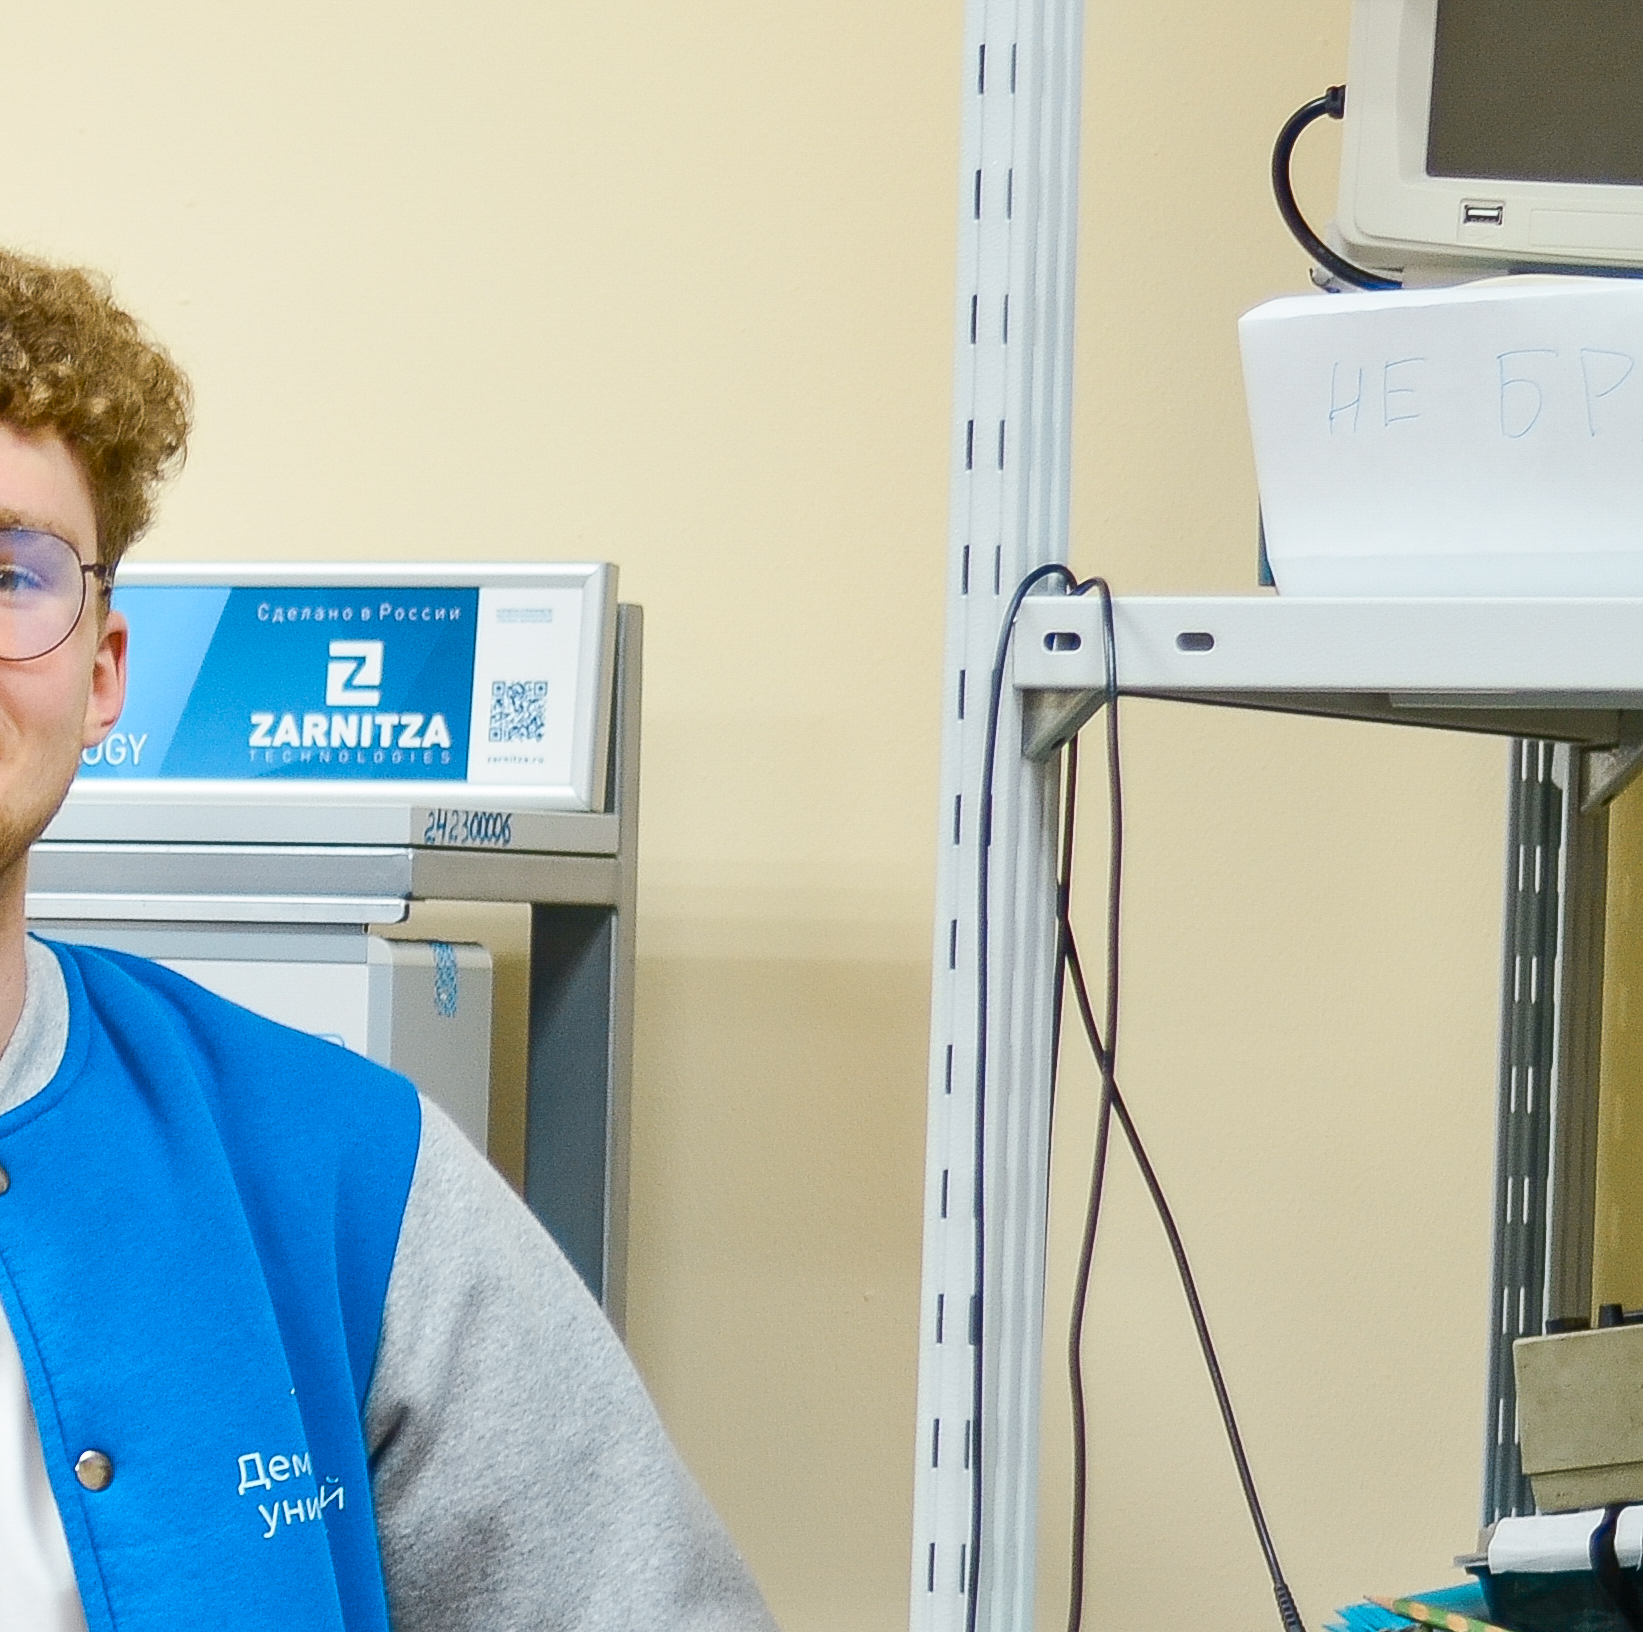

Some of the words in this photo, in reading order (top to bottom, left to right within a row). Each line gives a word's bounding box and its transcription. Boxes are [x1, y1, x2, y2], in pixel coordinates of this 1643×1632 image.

[1327, 356, 1429, 435] НЕ
[1495, 346, 1643, 440] БР
[256, 602, 353, 623] Сделано
[361, 607, 371, 621] в
[379, 602, 461, 622] России
[248, 713, 452, 749] ZARNITZA
[249, 750, 453, 765] TECHNOLOGIES
